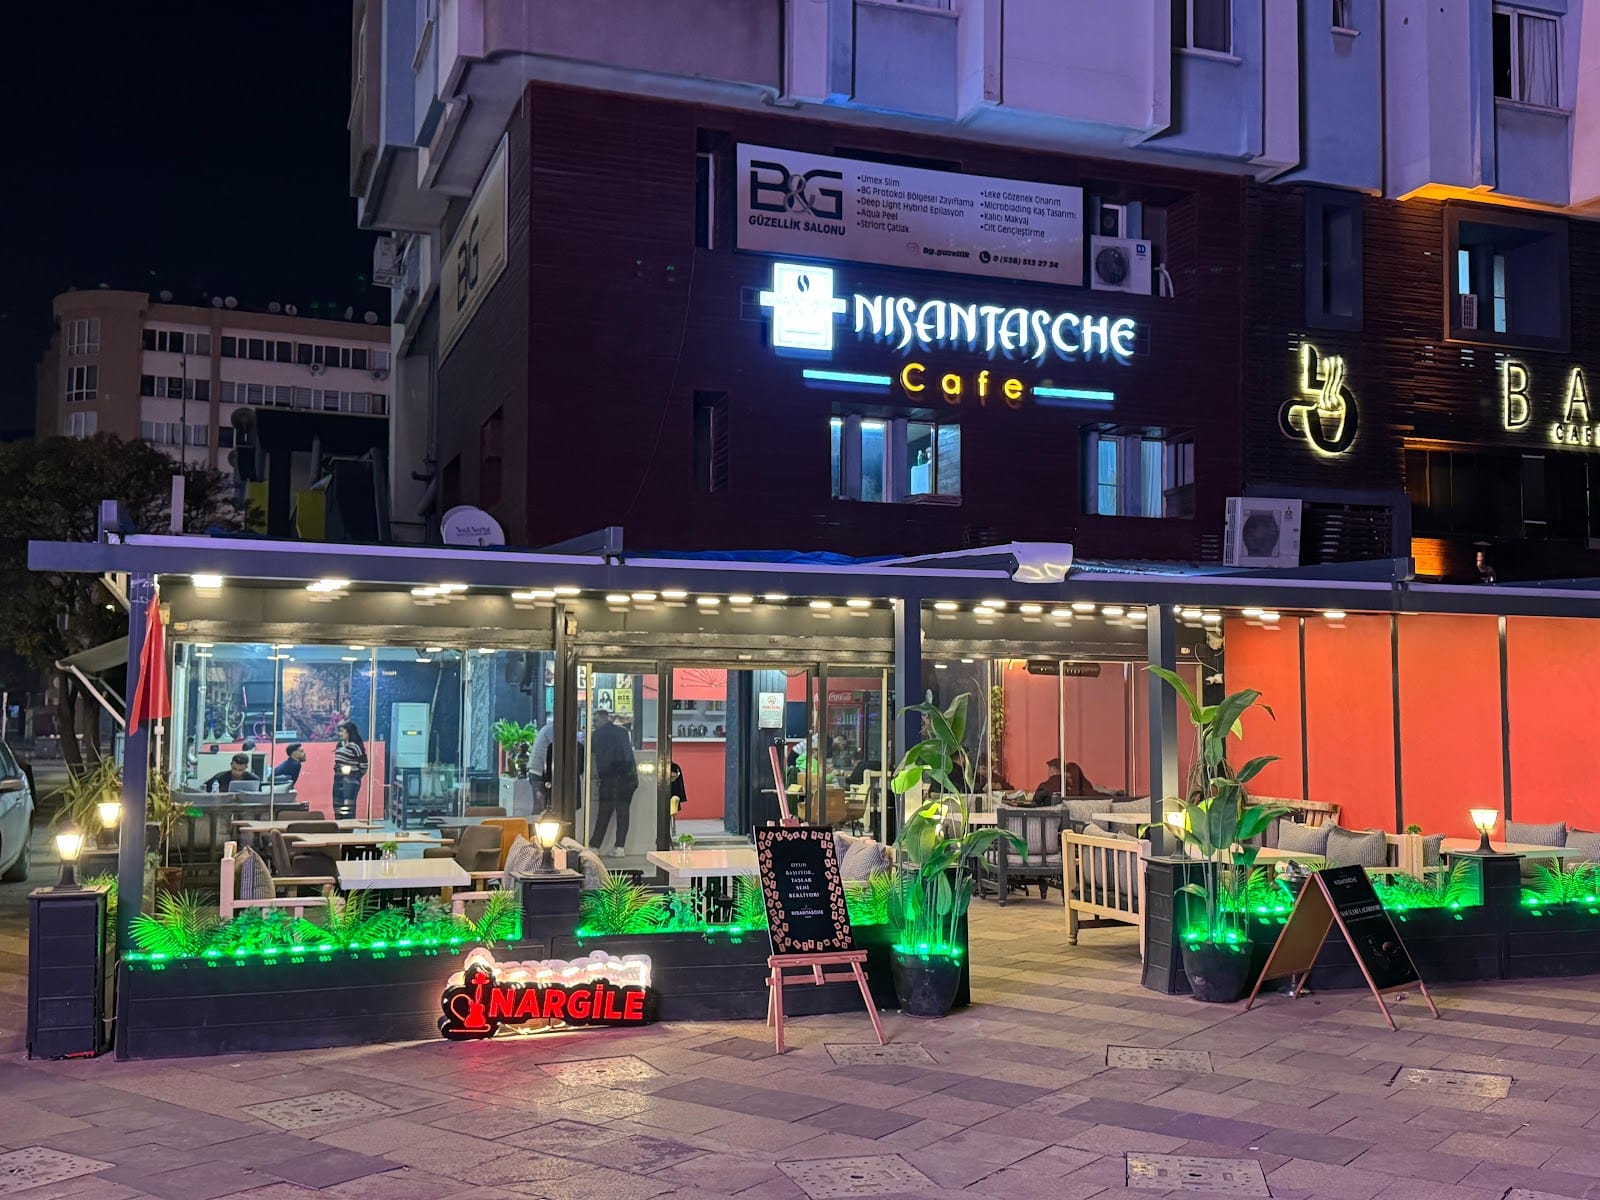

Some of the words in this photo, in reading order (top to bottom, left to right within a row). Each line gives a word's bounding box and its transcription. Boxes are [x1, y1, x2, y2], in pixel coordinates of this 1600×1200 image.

[861, 175, 882, 185] Umex
[885, 177, 900, 187] Slim
[861, 186, 871, 195] BG
[873, 187, 905, 199] Protokol
[907, 191, 938, 203] Bölgesel
[939, 195, 974, 207] Zayıflama
[984, 190, 1001, 199] Leke
[1002, 191, 1033, 203] Gözenek
[1034, 196, 1061, 206] Onarım
[861, 197, 881, 208] Deep
[882, 200, 902, 210] Light
[903, 203, 928, 213] Hybrid
[930, 206, 964, 218] Epilasyon
[861, 209, 880, 219] Aqua
[882, 211, 898, 221] Peel
[984, 201, 1032, 215] Microblading
[1033, 207, 1046, 217] Kaş
[749, 215, 801, 231] GÜZELLİK
[803, 221, 846, 236] SALONU
[887, 222, 910, 233] Çatlak
[1004, 214, 1029, 226] Makyaj
[984, 223, 996, 233] Cilt
[997, 225, 1045, 238] Gençleştirme
[852, 292, 1136, 363] NISANTASCHE
[900, 361, 1024, 400] Cafe
[487, 983, 647, 1020] NARGİLE
